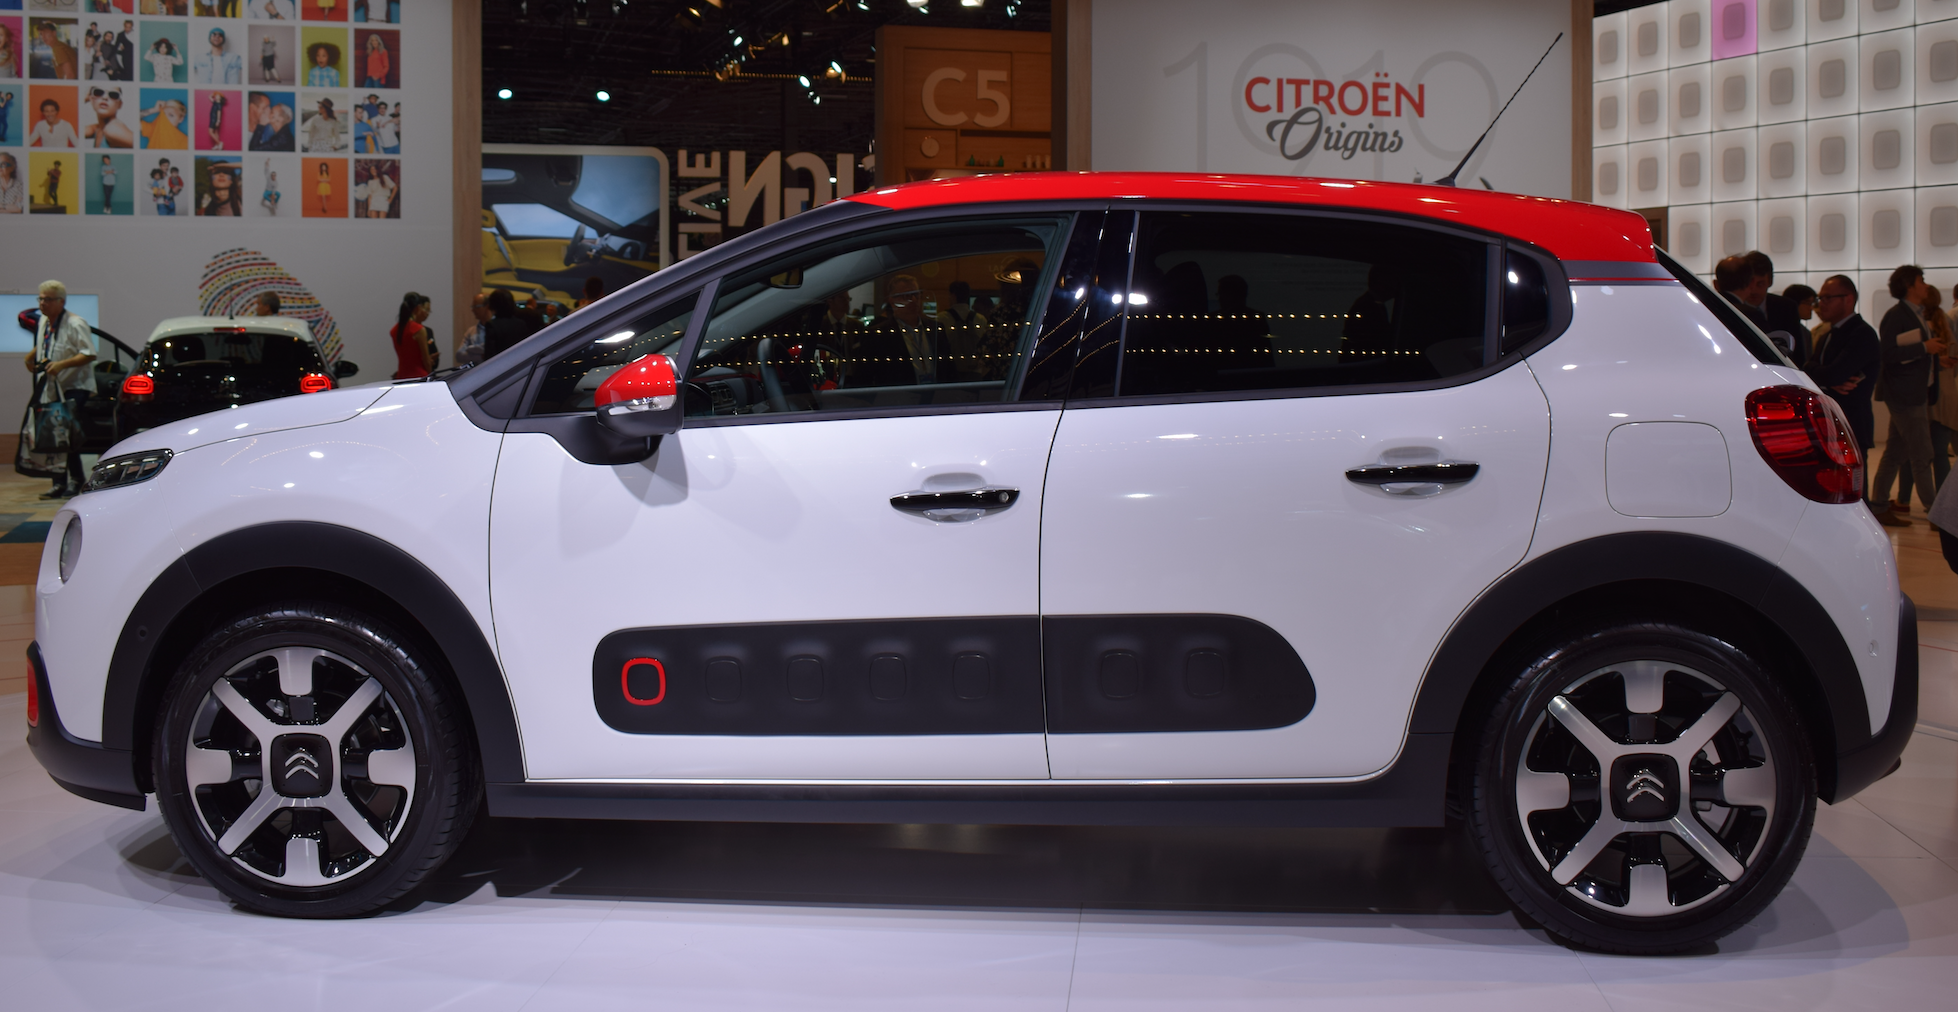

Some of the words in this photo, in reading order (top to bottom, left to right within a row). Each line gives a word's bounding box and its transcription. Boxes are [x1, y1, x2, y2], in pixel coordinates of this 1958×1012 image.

[921, 67, 1011, 128] C5
[1244, 71, 1425, 118] CITROËN
[1266, 106, 1404, 161] Origins
